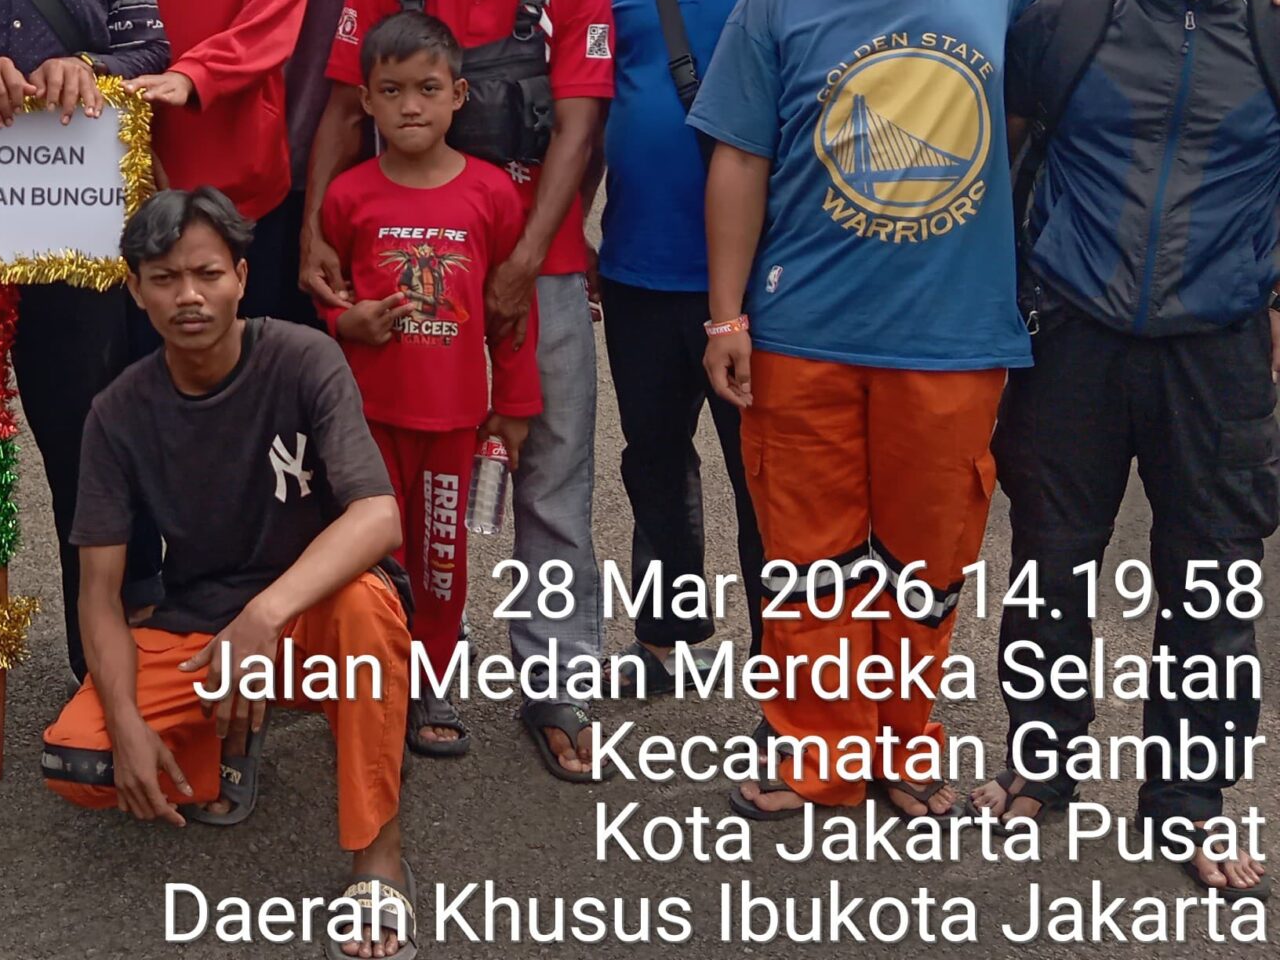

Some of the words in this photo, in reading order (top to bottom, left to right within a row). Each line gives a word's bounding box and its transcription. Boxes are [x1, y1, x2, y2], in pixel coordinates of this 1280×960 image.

[921, 32, 994, 80] STATE
[378, 227, 425, 239] FREE
[425, 228, 468, 242] FIRE
[822, 180, 986, 244] WARRIORS
[433, 473, 459, 540] FREE
